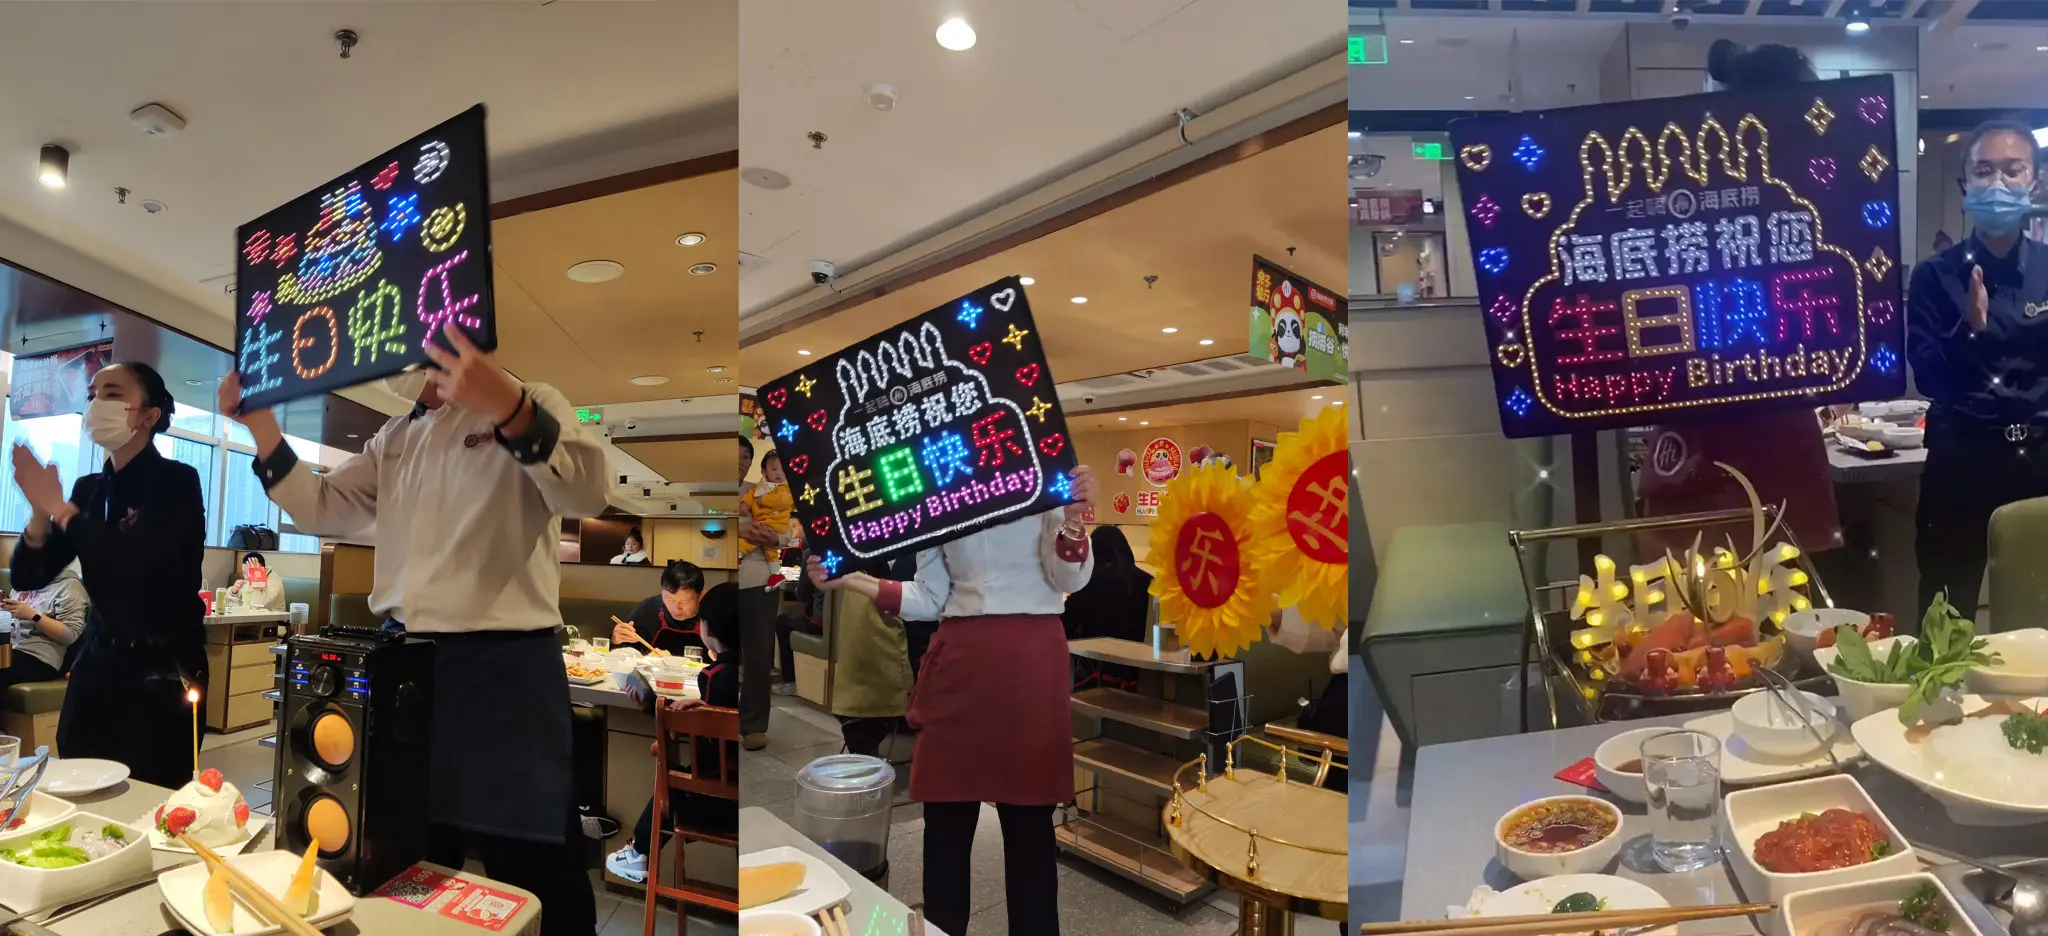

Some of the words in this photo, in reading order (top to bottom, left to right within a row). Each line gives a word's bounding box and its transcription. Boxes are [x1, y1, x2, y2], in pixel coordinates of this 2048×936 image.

[1698, 186, 1760, 211] 海底捞
[1557, 209, 1815, 286] 海底捞祝您
[240, 249, 482, 399] 生日快乐
[1548, 265, 1843, 366] 生日快乐
[907, 370, 948, 396] 海底捞
[1552, 365, 1677, 404] Happy
[1686, 341, 1853, 388] Birthday
[839, 380, 983, 460] 海底捞祝您
[837, 410, 1023, 518] 生日快乐
[849, 504, 921, 544] Happy
[926, 467, 1035, 518] Birthday
[1181, 527, 1225, 596] 乐
